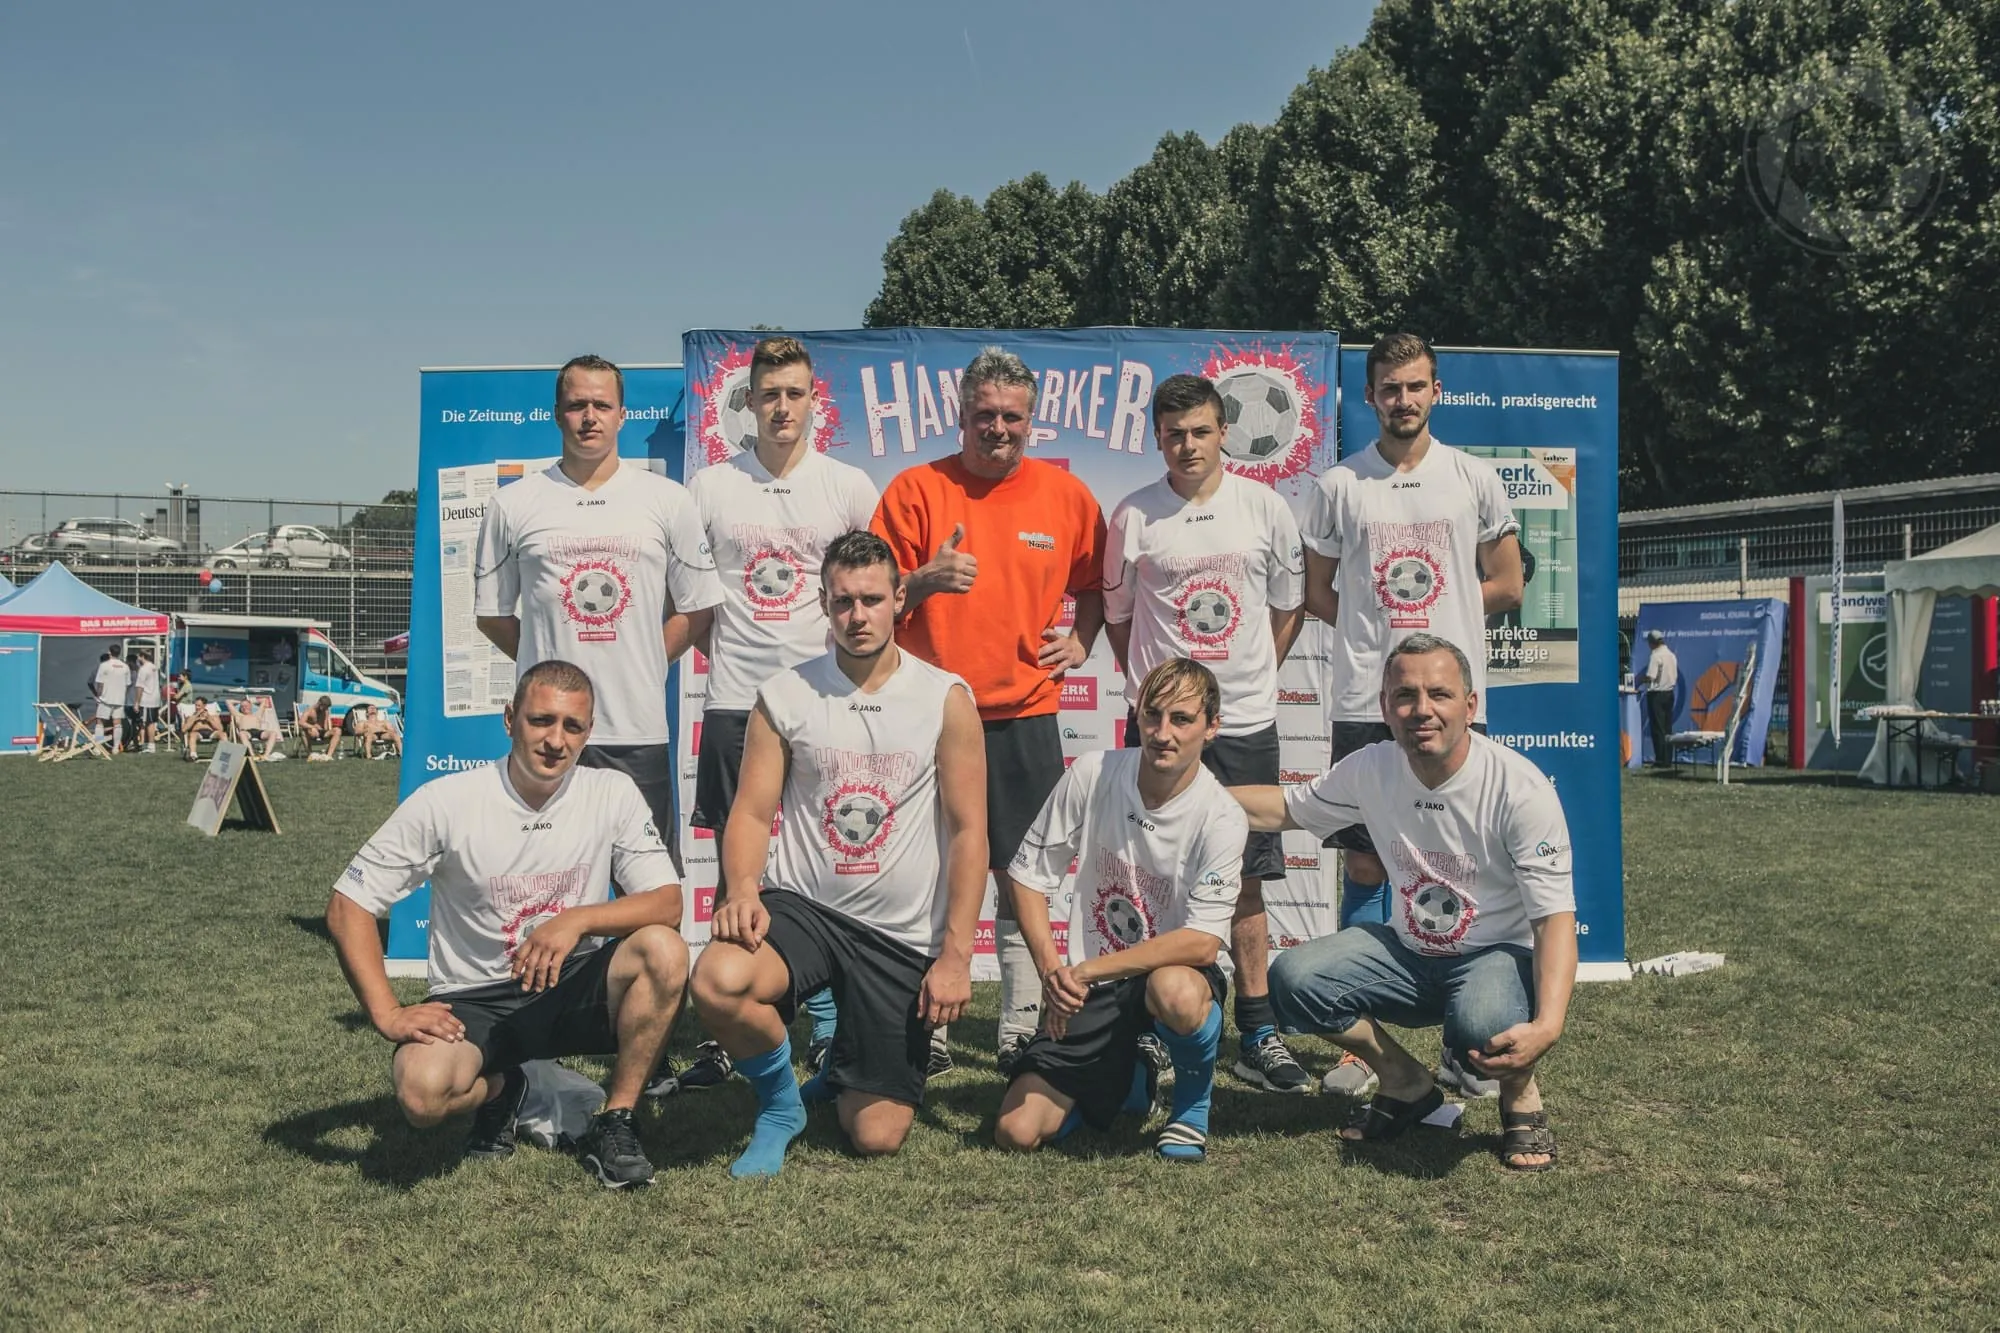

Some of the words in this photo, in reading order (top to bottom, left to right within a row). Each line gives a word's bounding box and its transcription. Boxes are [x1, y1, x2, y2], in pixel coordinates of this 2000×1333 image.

[860, 359, 1153, 456] HANRKER
[1439, 391, 1496, 407] lässlich.
[1501, 392, 1598, 410] praxisgerecht
[442, 409, 466, 423] Die
[468, 408, 526, 425] Zeitung,
[529, 407, 551, 421] die
[1497, 464, 1535, 482] erk
[1195, 514, 1215, 522] JAKO
[80, 619, 100, 627] DAS
[103, 617, 157, 627] HANDWERK
[1485, 625, 1538, 641] erfekte
[858, 704, 882, 713] JAKO
[814, 747, 917, 788] HANDWERKER
[1424, 801, 1445, 812] JAKO
[531, 822, 552, 832] JAKO
[489, 863, 592, 910] HANDWERKER
